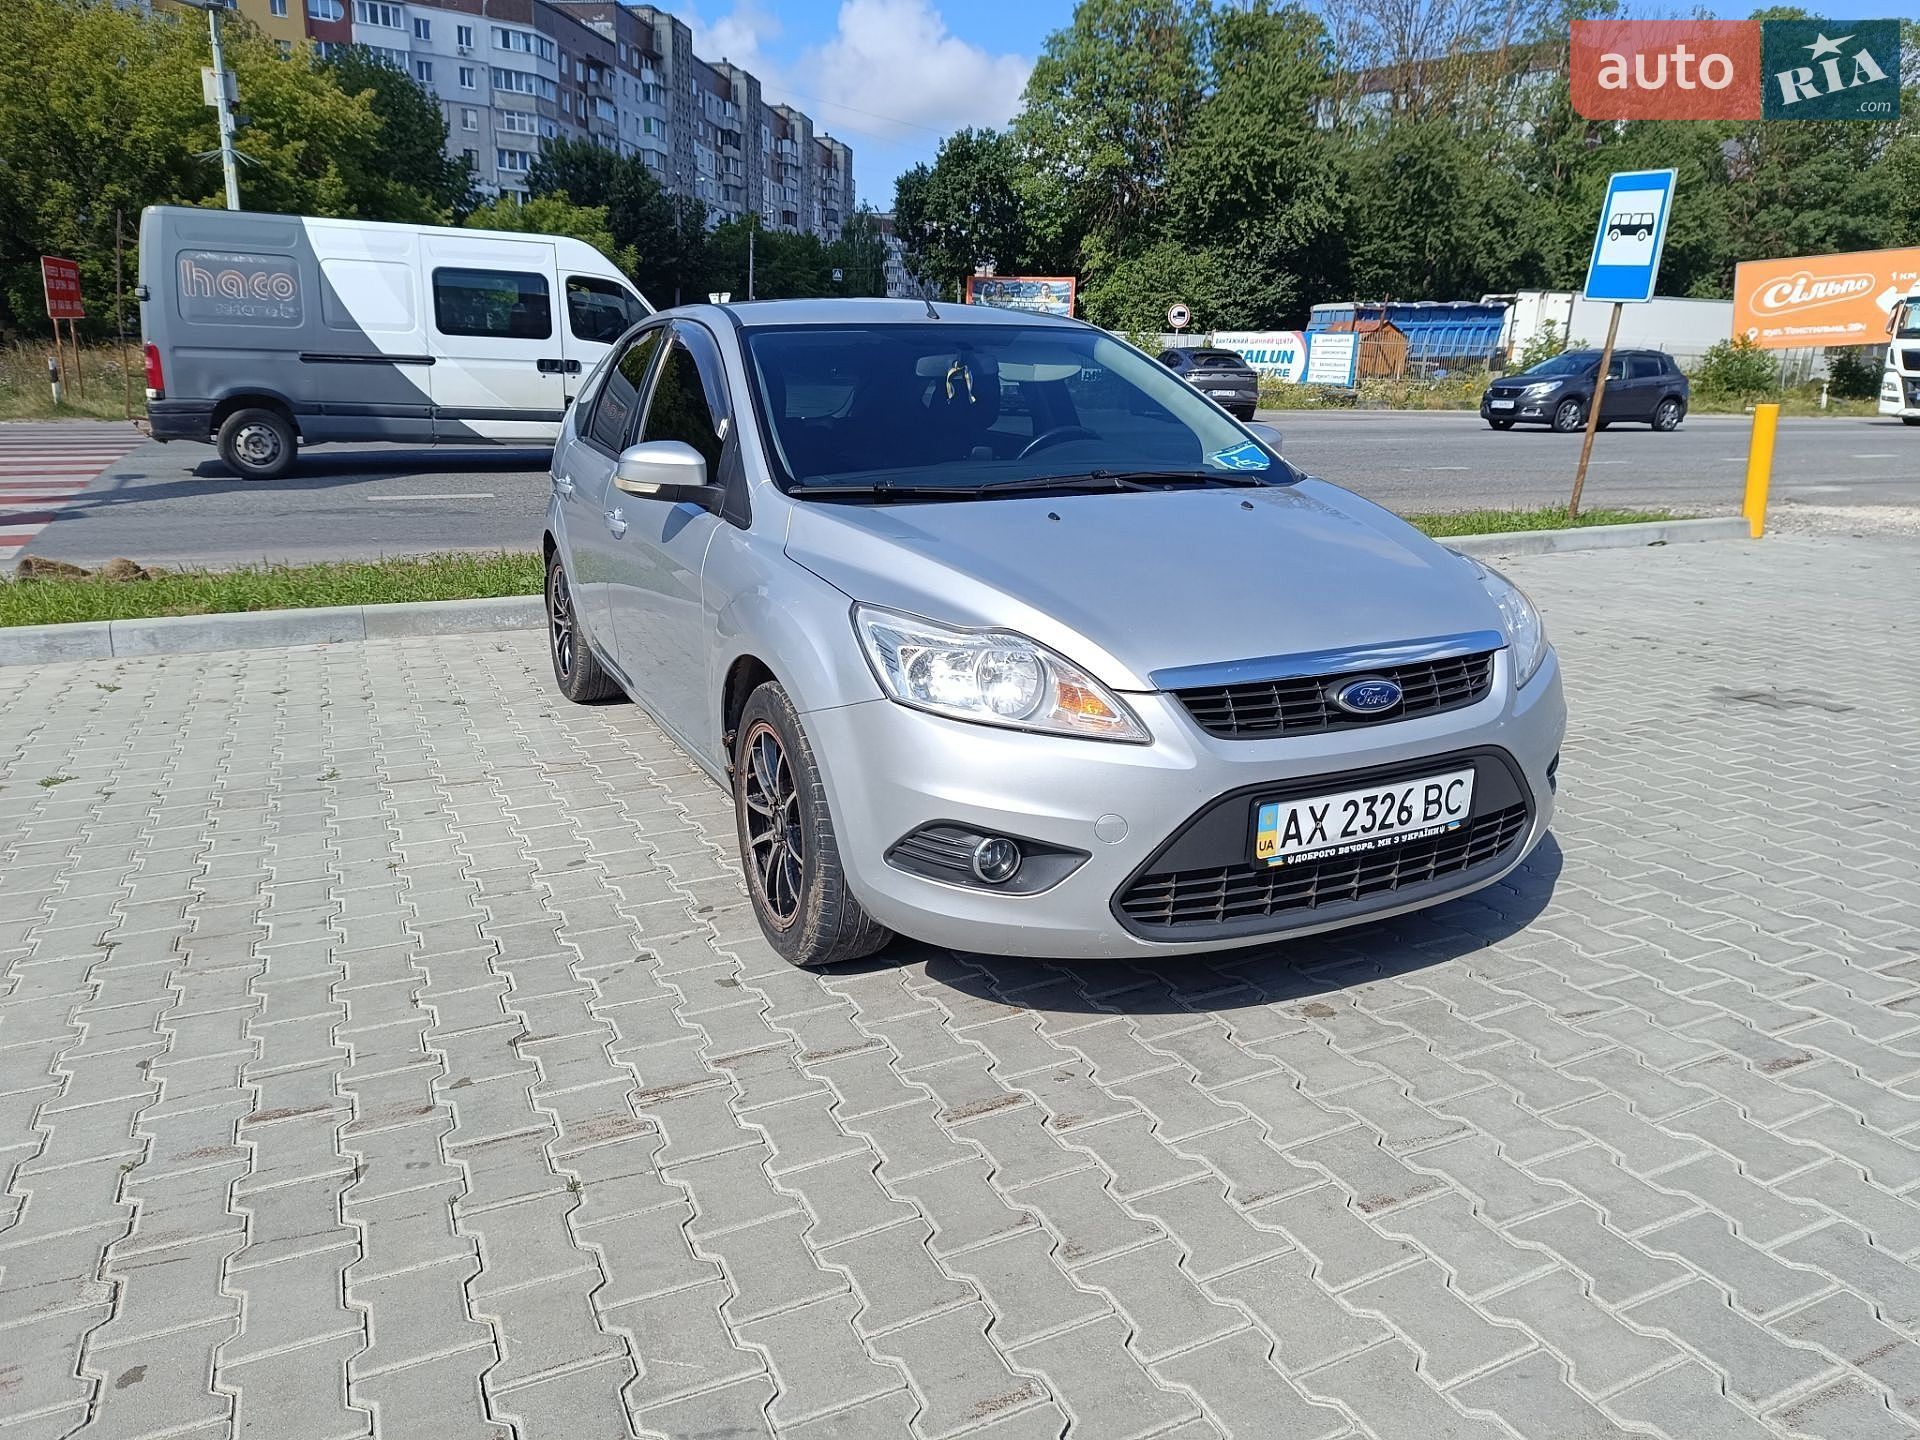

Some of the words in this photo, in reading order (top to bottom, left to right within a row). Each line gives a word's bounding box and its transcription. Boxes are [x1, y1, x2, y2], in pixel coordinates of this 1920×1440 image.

[180, 259, 297, 301] haco
[1763, 277, 1869, 308] Сільпо
[1357, 687, 1390, 705] Ford
[1280, 803, 1331, 849] AX
[1340, 788, 1415, 839] 2326
[1422, 778, 1465, 822] BC
[1258, 839, 1274, 851] UA
